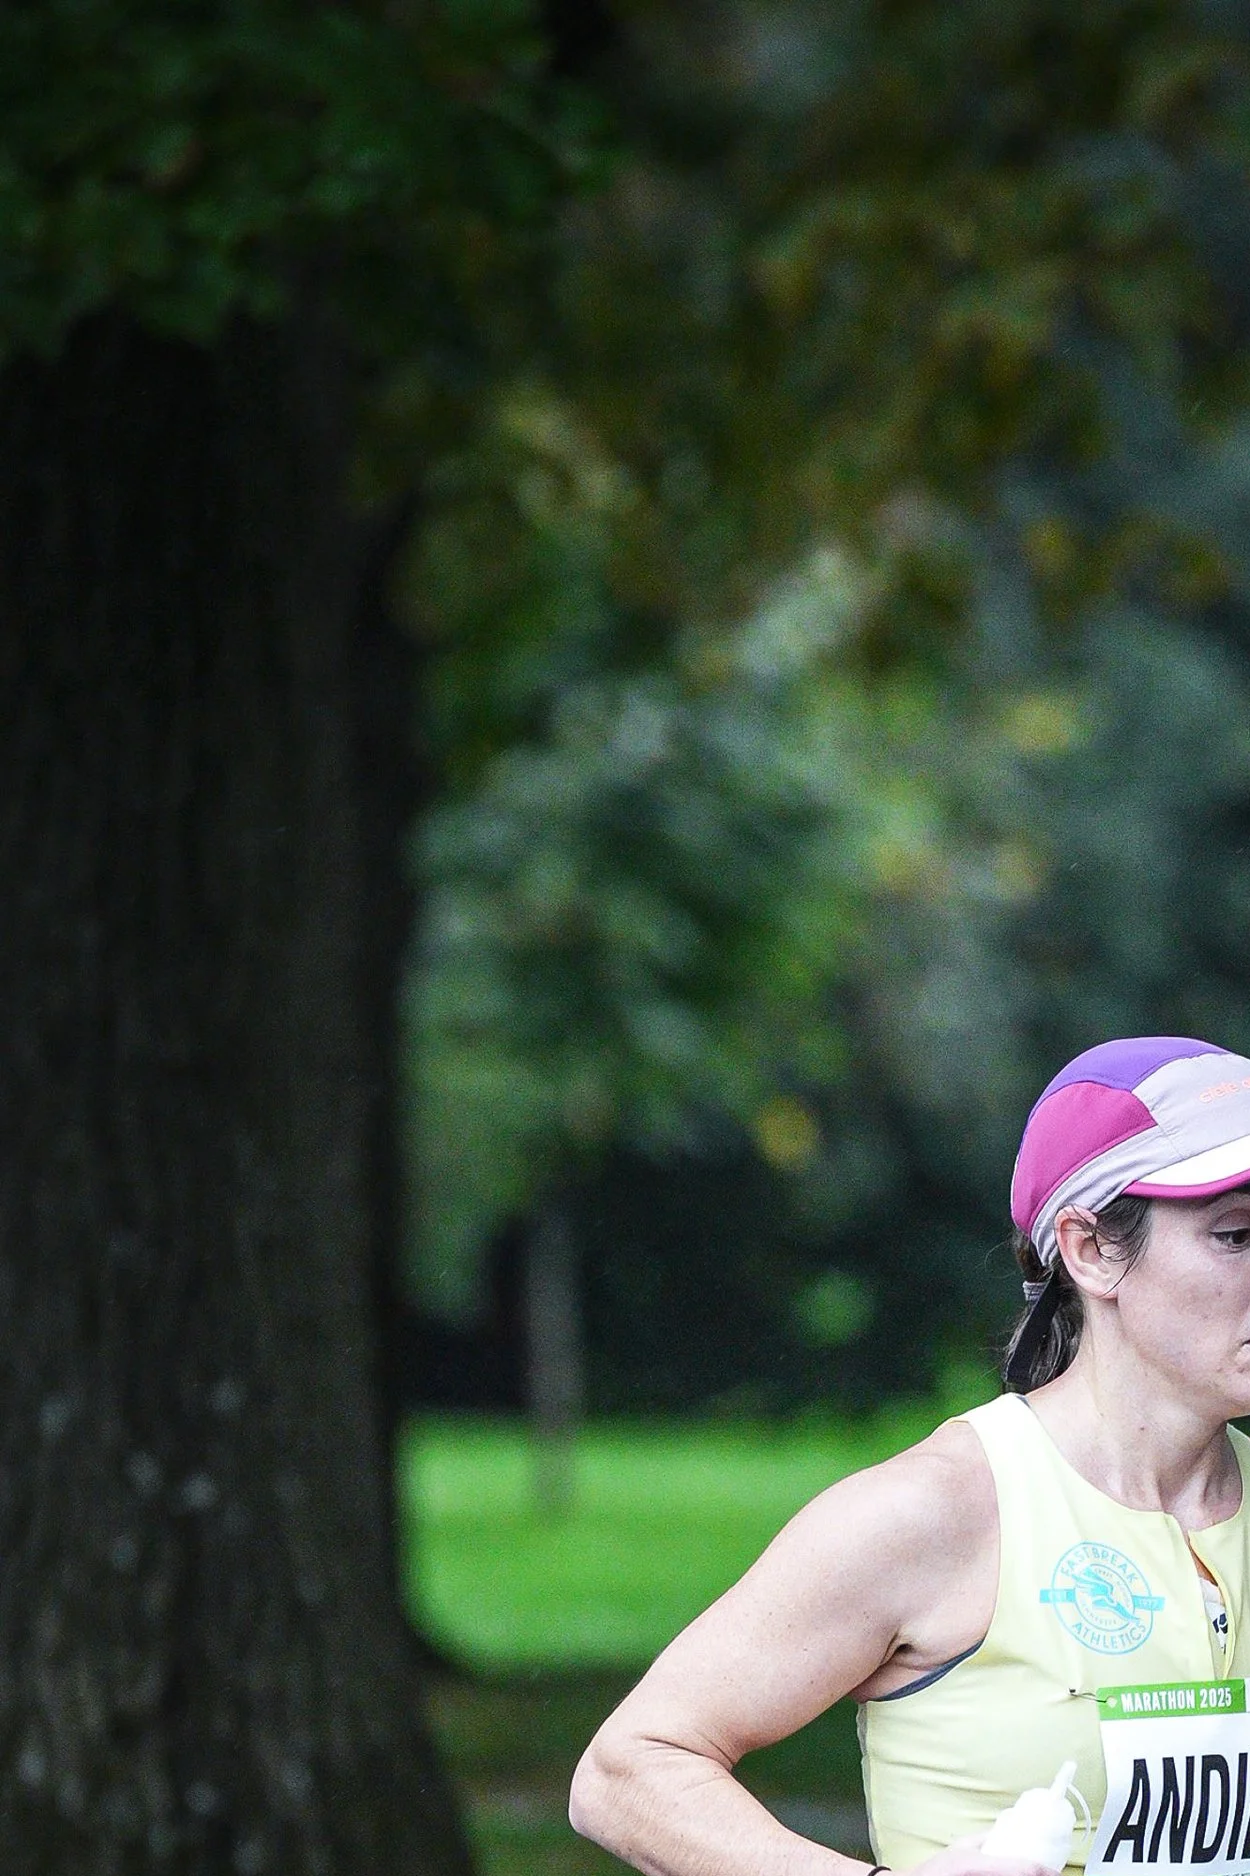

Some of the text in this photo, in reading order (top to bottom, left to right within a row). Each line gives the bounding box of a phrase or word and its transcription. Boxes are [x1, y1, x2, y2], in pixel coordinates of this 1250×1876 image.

[1072, 1621, 1146, 1649] ATHLETICS
[1121, 1687, 1232, 1713] MARATHON 2025
